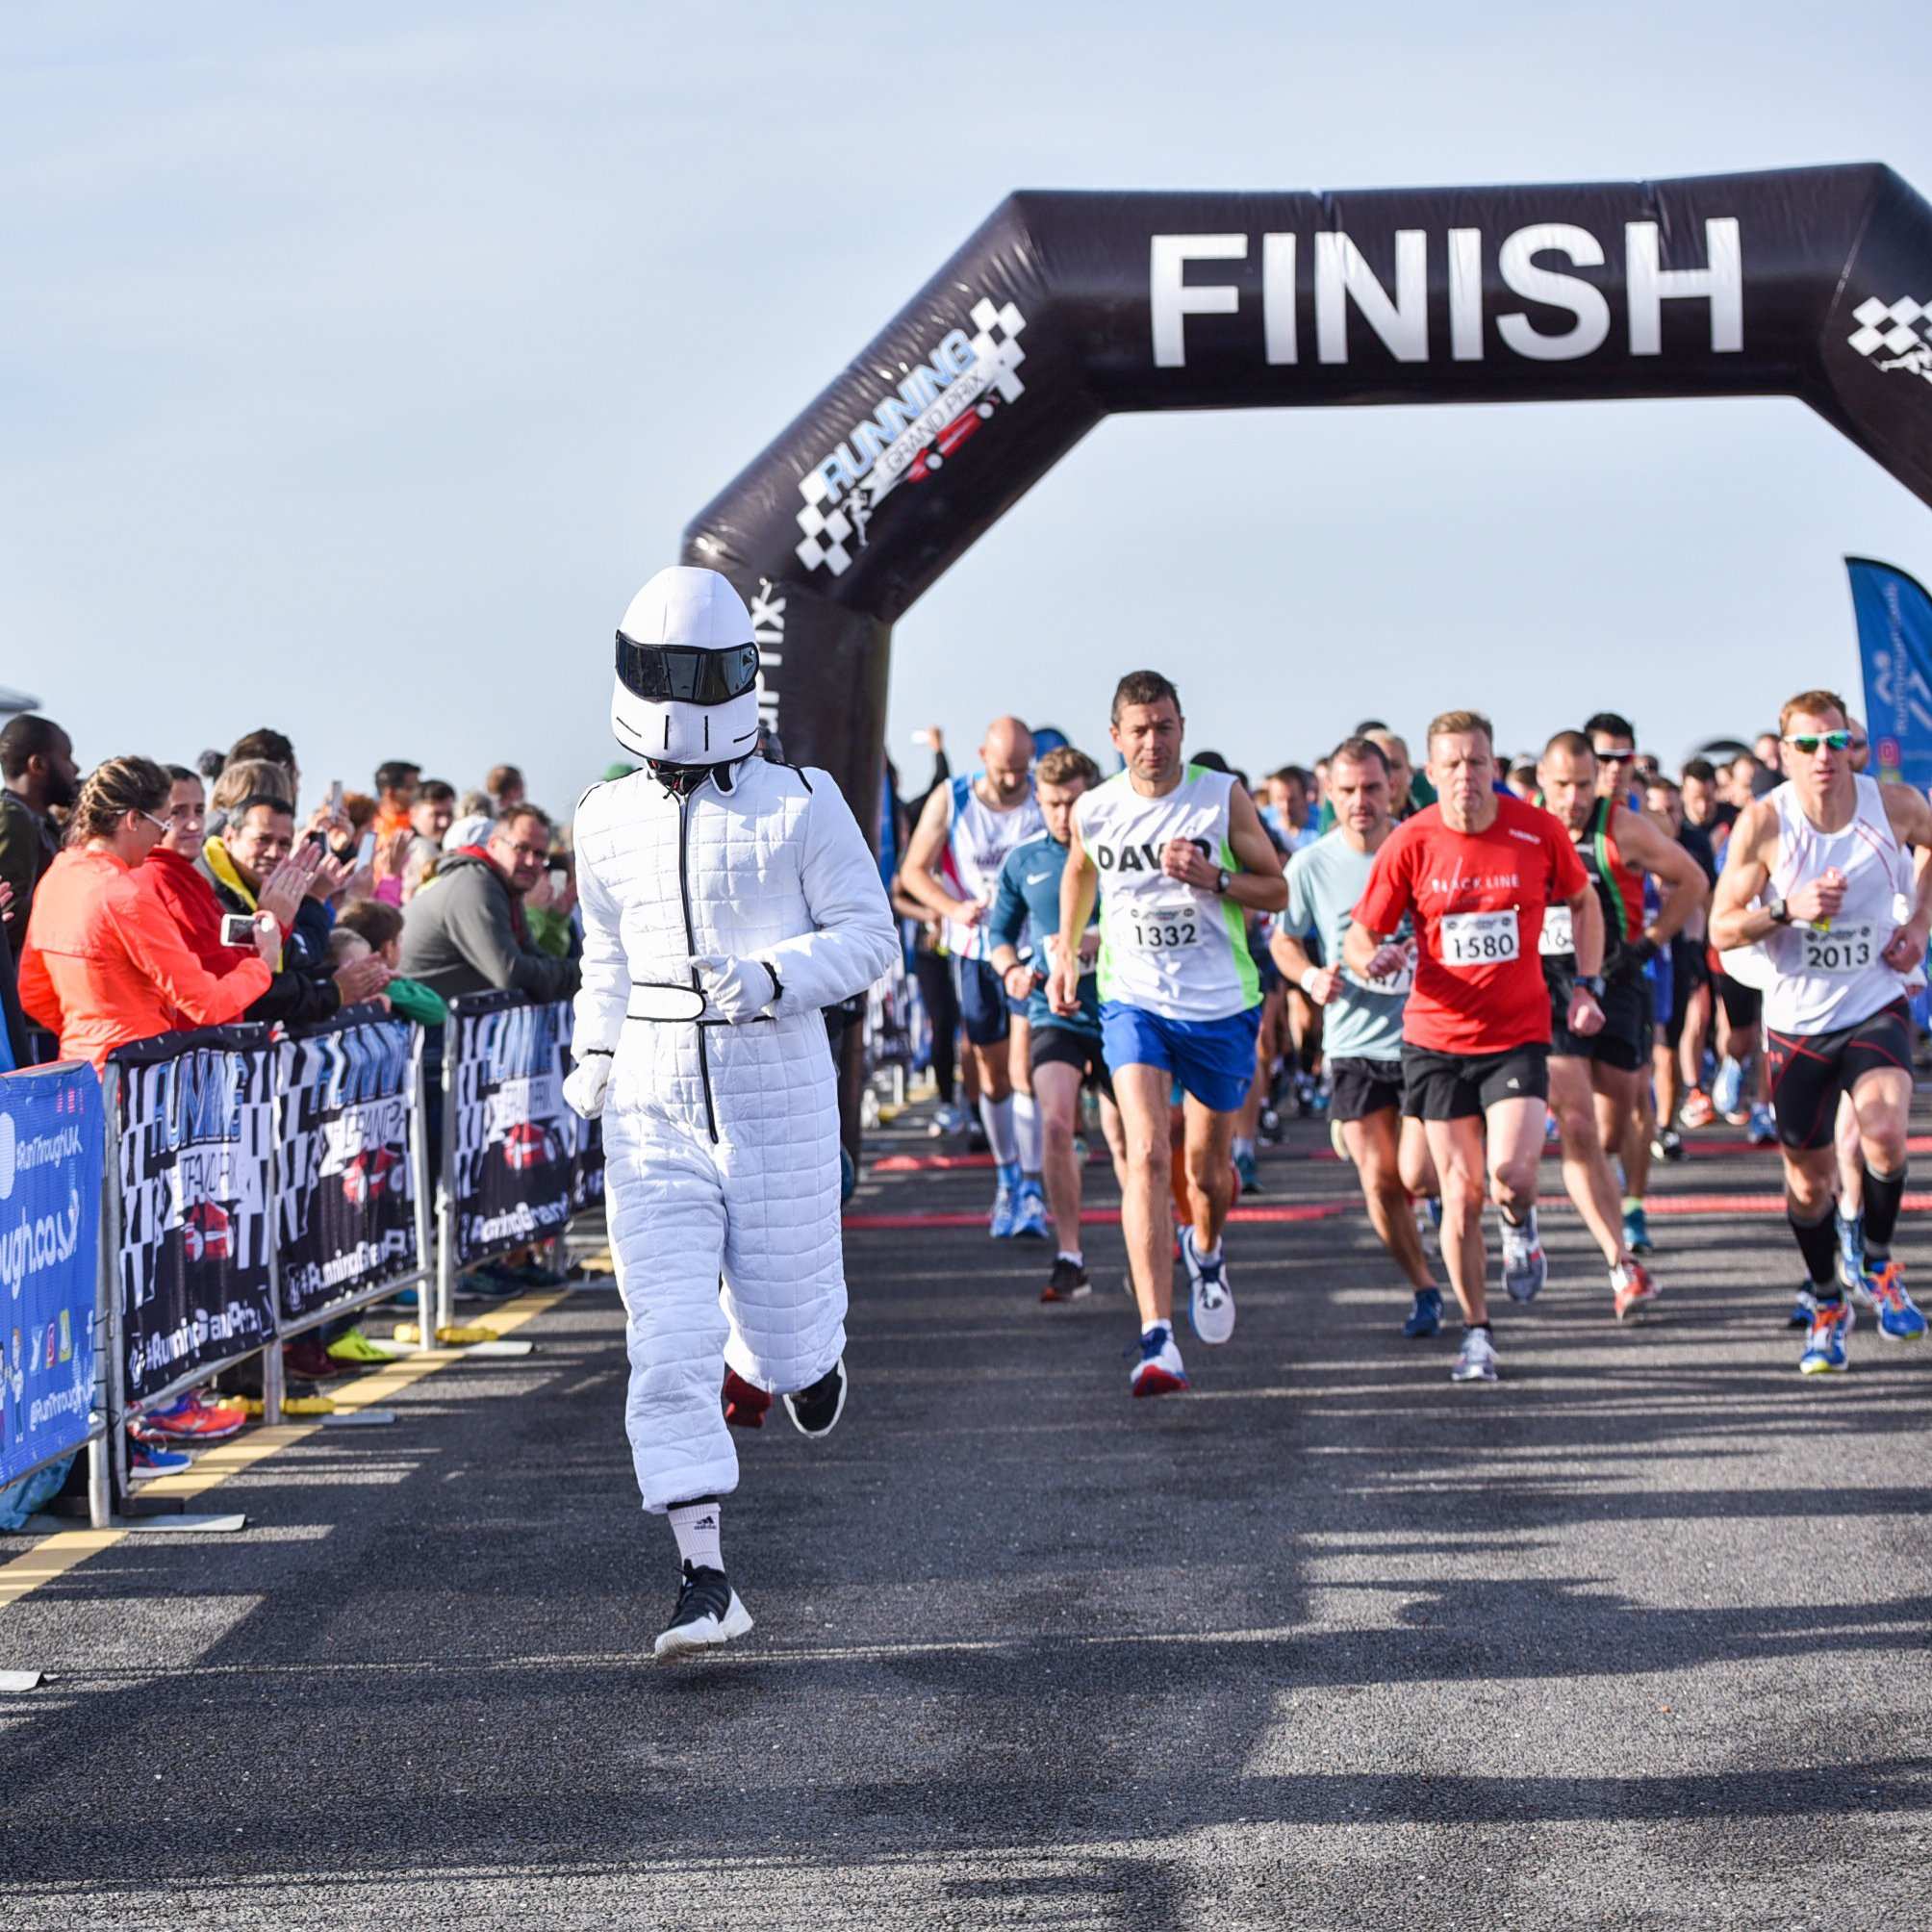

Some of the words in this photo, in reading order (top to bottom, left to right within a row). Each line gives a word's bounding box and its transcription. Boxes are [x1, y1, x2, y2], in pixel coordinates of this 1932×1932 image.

[1151, 217, 1744, 369] FINISH
[817, 328, 979, 504] RUNNING
[886, 412, 945, 471] GRAND
[946, 375, 985, 412] PRIX
[1098, 838, 1212, 873] DAVD
[1486, 874, 1520, 889] LINE
[1135, 924, 1197, 948] 1332
[1453, 933, 1514, 959] 1580
[1807, 942, 1870, 969] 2013
